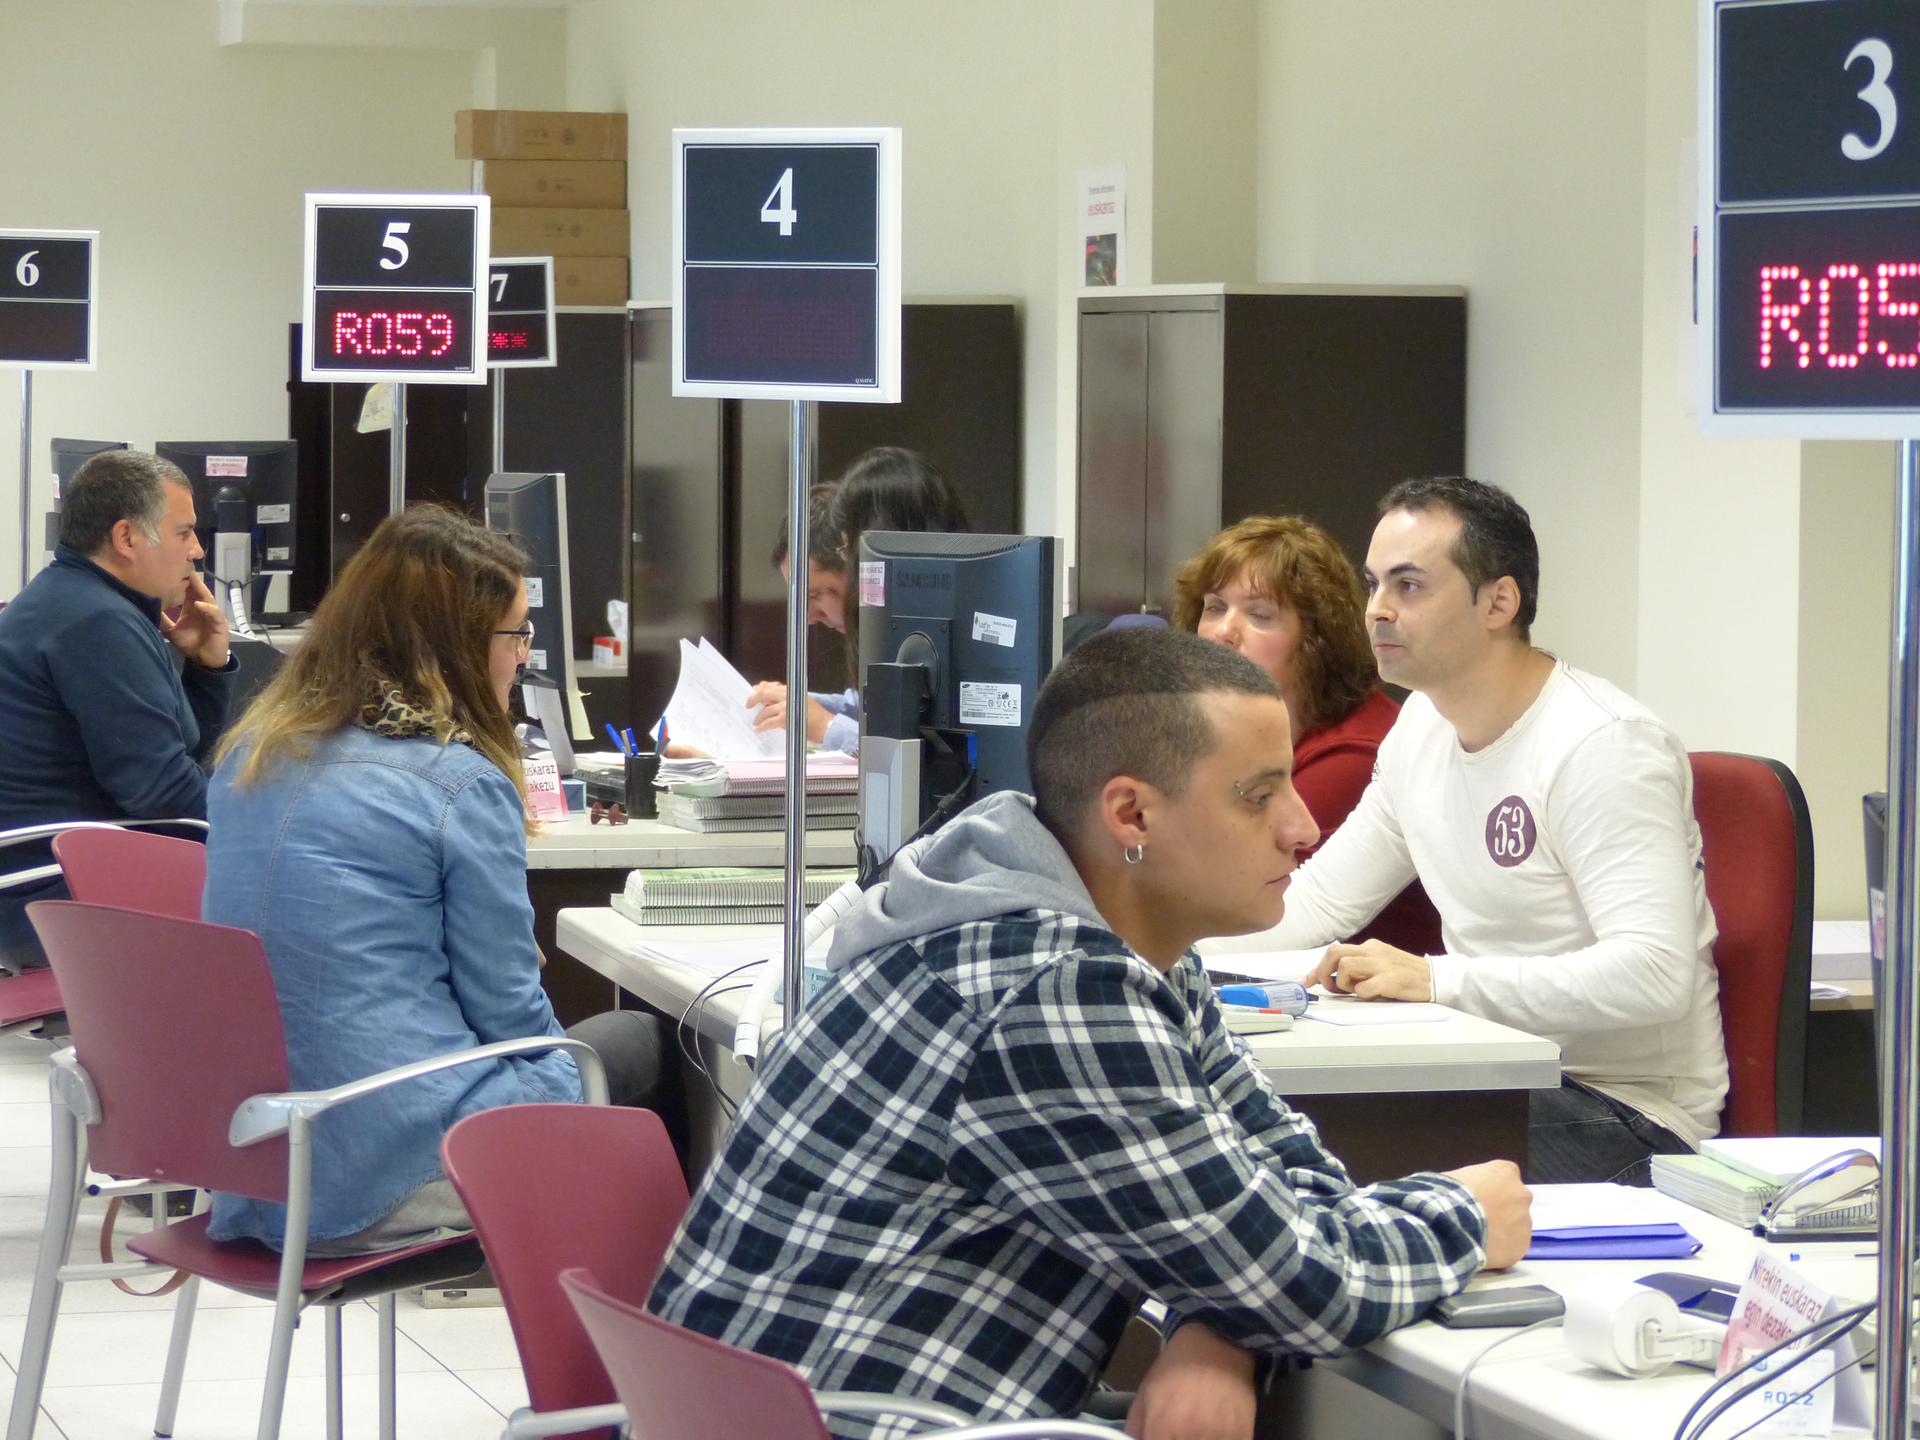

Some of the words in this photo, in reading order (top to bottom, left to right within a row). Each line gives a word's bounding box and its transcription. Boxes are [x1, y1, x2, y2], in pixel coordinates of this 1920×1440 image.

[1841, 38, 1897, 161] 3
[761, 167, 797, 236] 4
[16, 250, 40, 287] 6
[379, 222, 411, 270] 5
[490, 273, 509, 303] 7
[1494, 805, 1526, 857] 53
[1748, 1255, 1782, 1297] Nirekin
[1780, 1284, 1823, 1324] euskaraz
